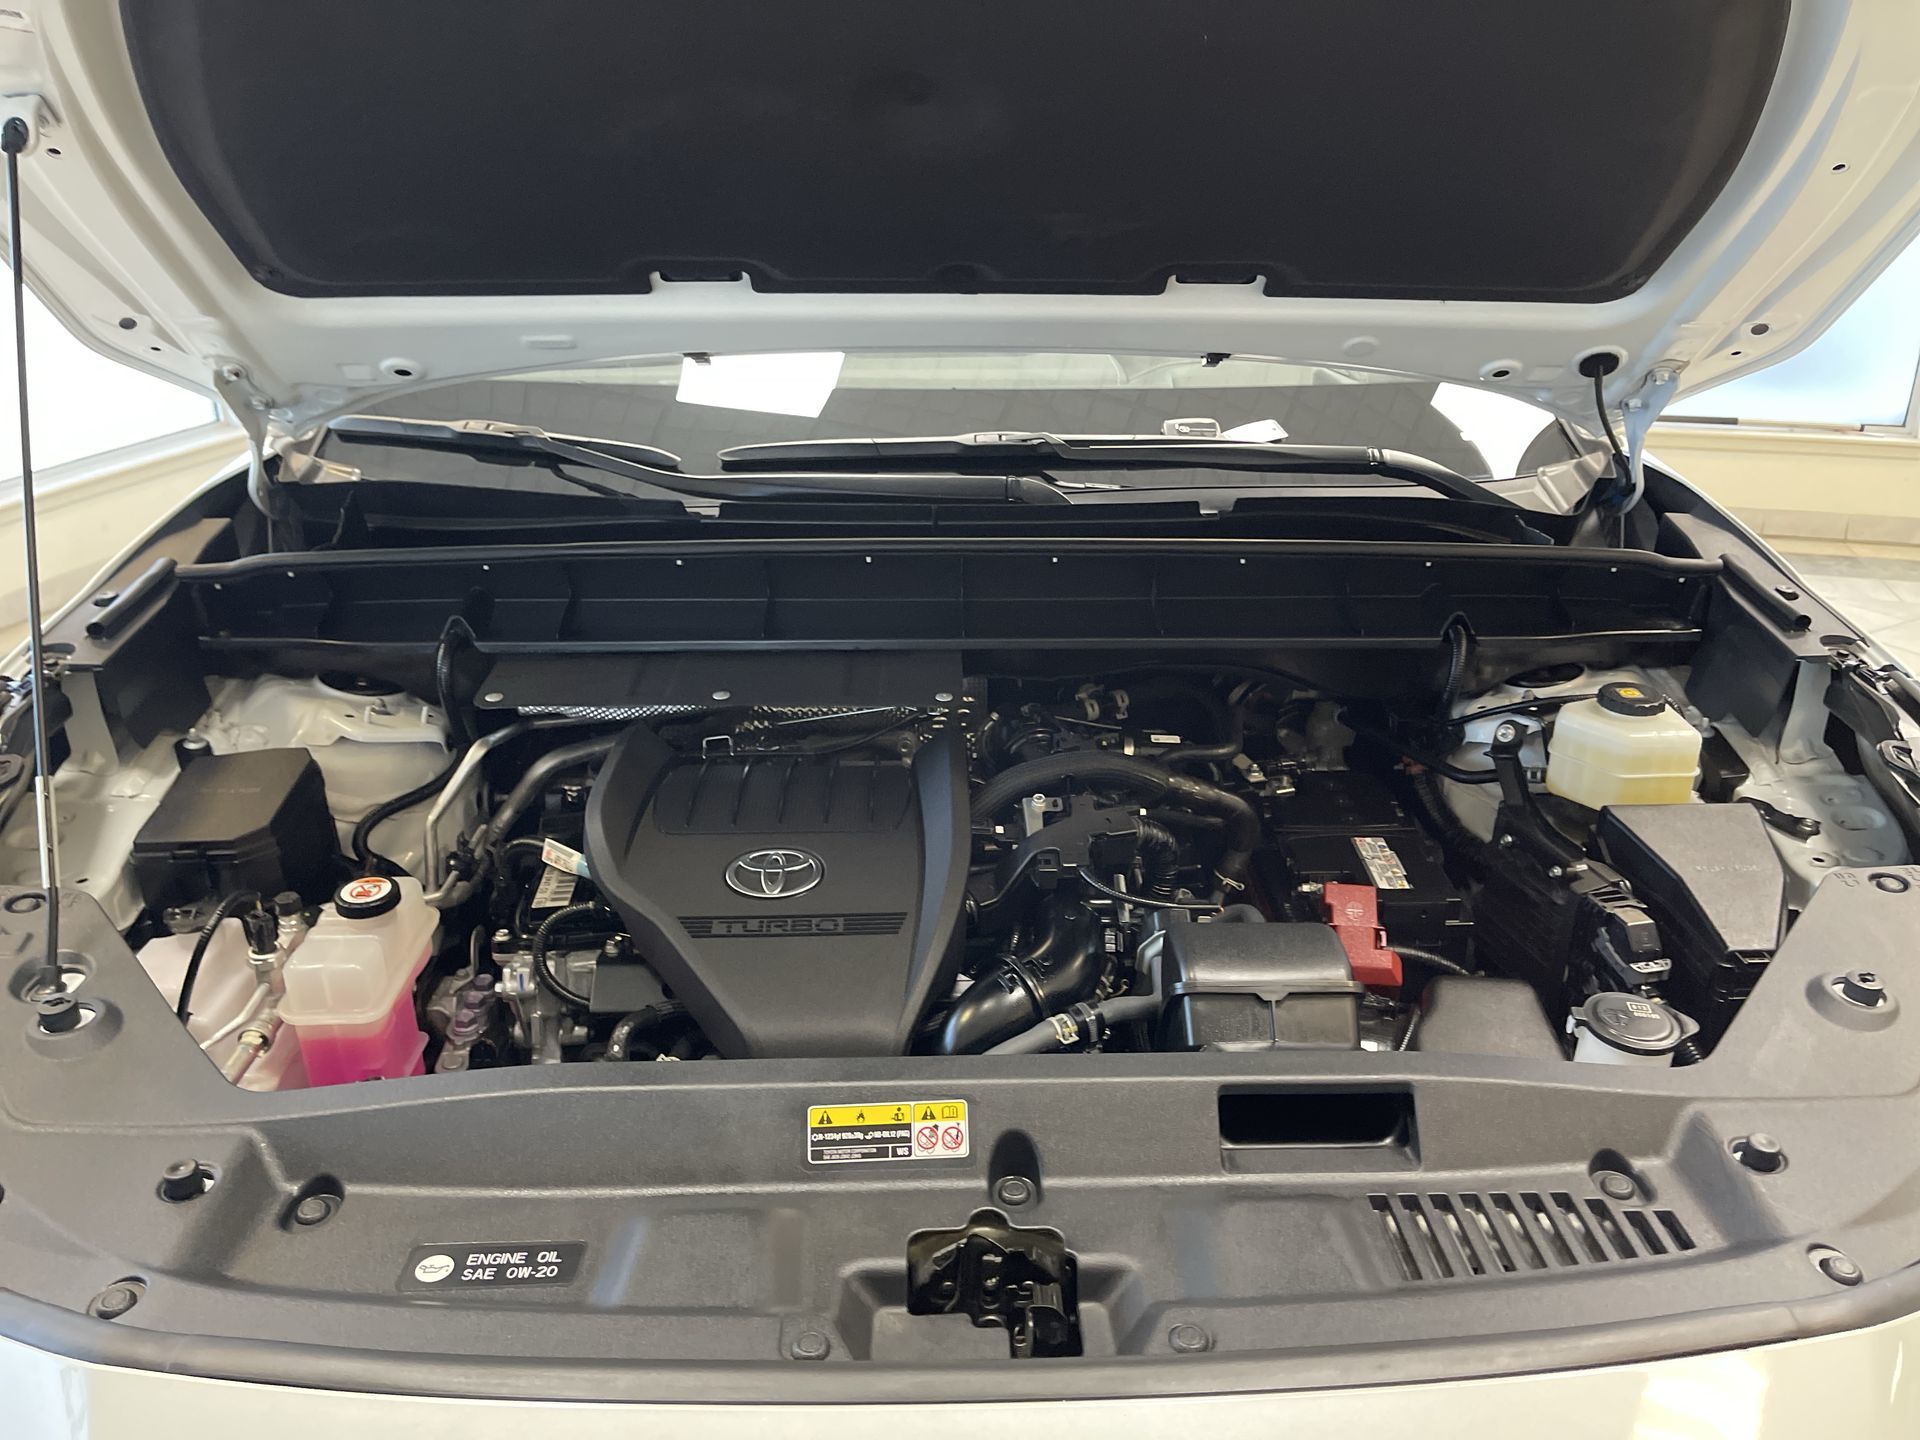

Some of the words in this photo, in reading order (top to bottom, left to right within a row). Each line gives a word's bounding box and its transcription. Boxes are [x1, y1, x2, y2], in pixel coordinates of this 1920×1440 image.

[717, 919, 840, 932] TURBO
[896, 1147, 909, 1156] WS
[466, 1252, 528, 1266] ENGINE
[537, 1251, 562, 1263] OIL
[461, 1268, 497, 1281] SAE
[506, 1265, 558, 1279] 0W-20
